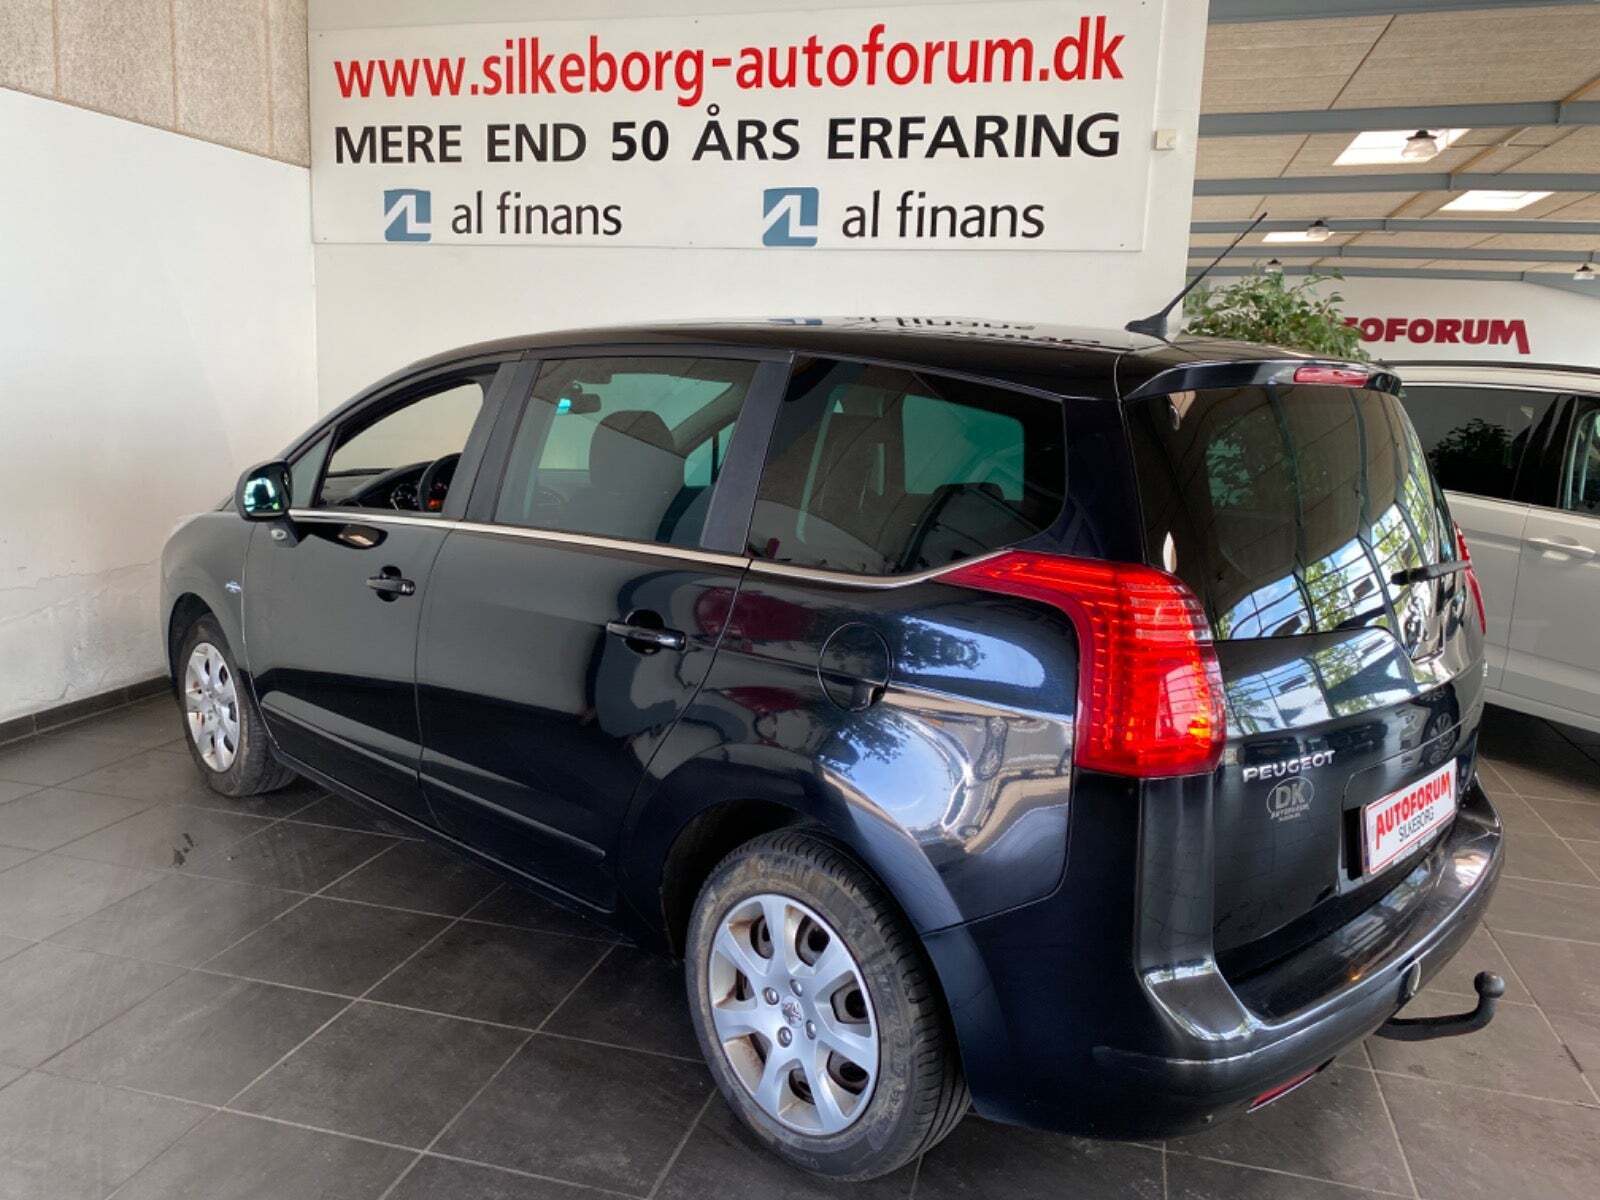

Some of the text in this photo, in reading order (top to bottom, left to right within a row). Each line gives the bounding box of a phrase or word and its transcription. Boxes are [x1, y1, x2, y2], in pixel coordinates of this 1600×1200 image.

[335, 16, 1125, 108] www.silkeborg-autoforum.dk
[335, 104, 1120, 163] MERE END 50 ÅRS ERFARING
[452, 191, 622, 236] al finans
[842, 190, 1044, 239] al finans
[1242, 750, 1336, 782] PEUGEOT
[1275, 782, 1306, 809] DK
[1375, 771, 1452, 849] AUTOFORUM
[1398, 806, 1434, 842] SILKEBORG
